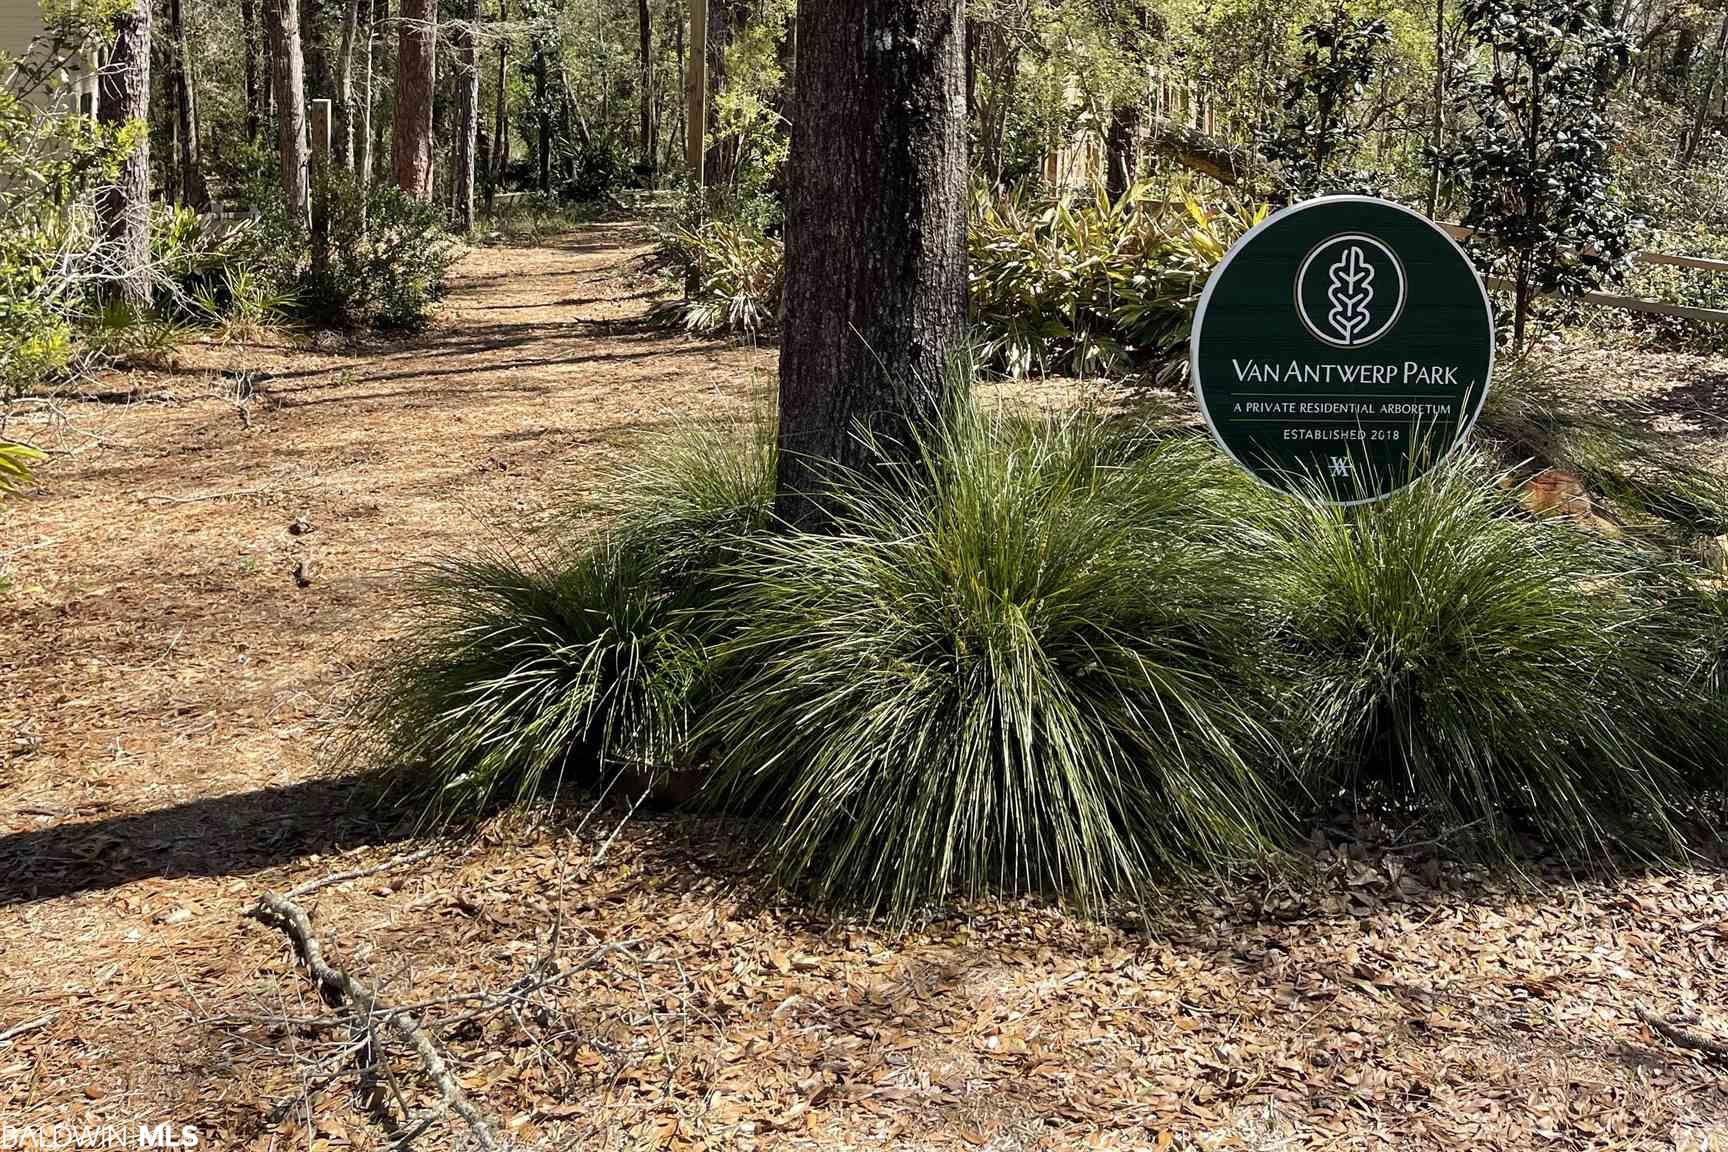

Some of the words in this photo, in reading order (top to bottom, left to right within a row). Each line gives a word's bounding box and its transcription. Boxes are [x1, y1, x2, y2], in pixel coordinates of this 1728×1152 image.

[1283, 360, 1398, 384] ANTWERP
[1403, 361, 1458, 385] PARK
[1233, 402, 1242, 413] A
[1246, 402, 1296, 413] PRIVATE
[1300, 403, 1375, 414] RESIDENTIAL
[1380, 404, 1451, 414] ARBORETUM
[1283, 429, 1366, 440] ESTABLISHED
[1370, 430, 1400, 441] 2018
